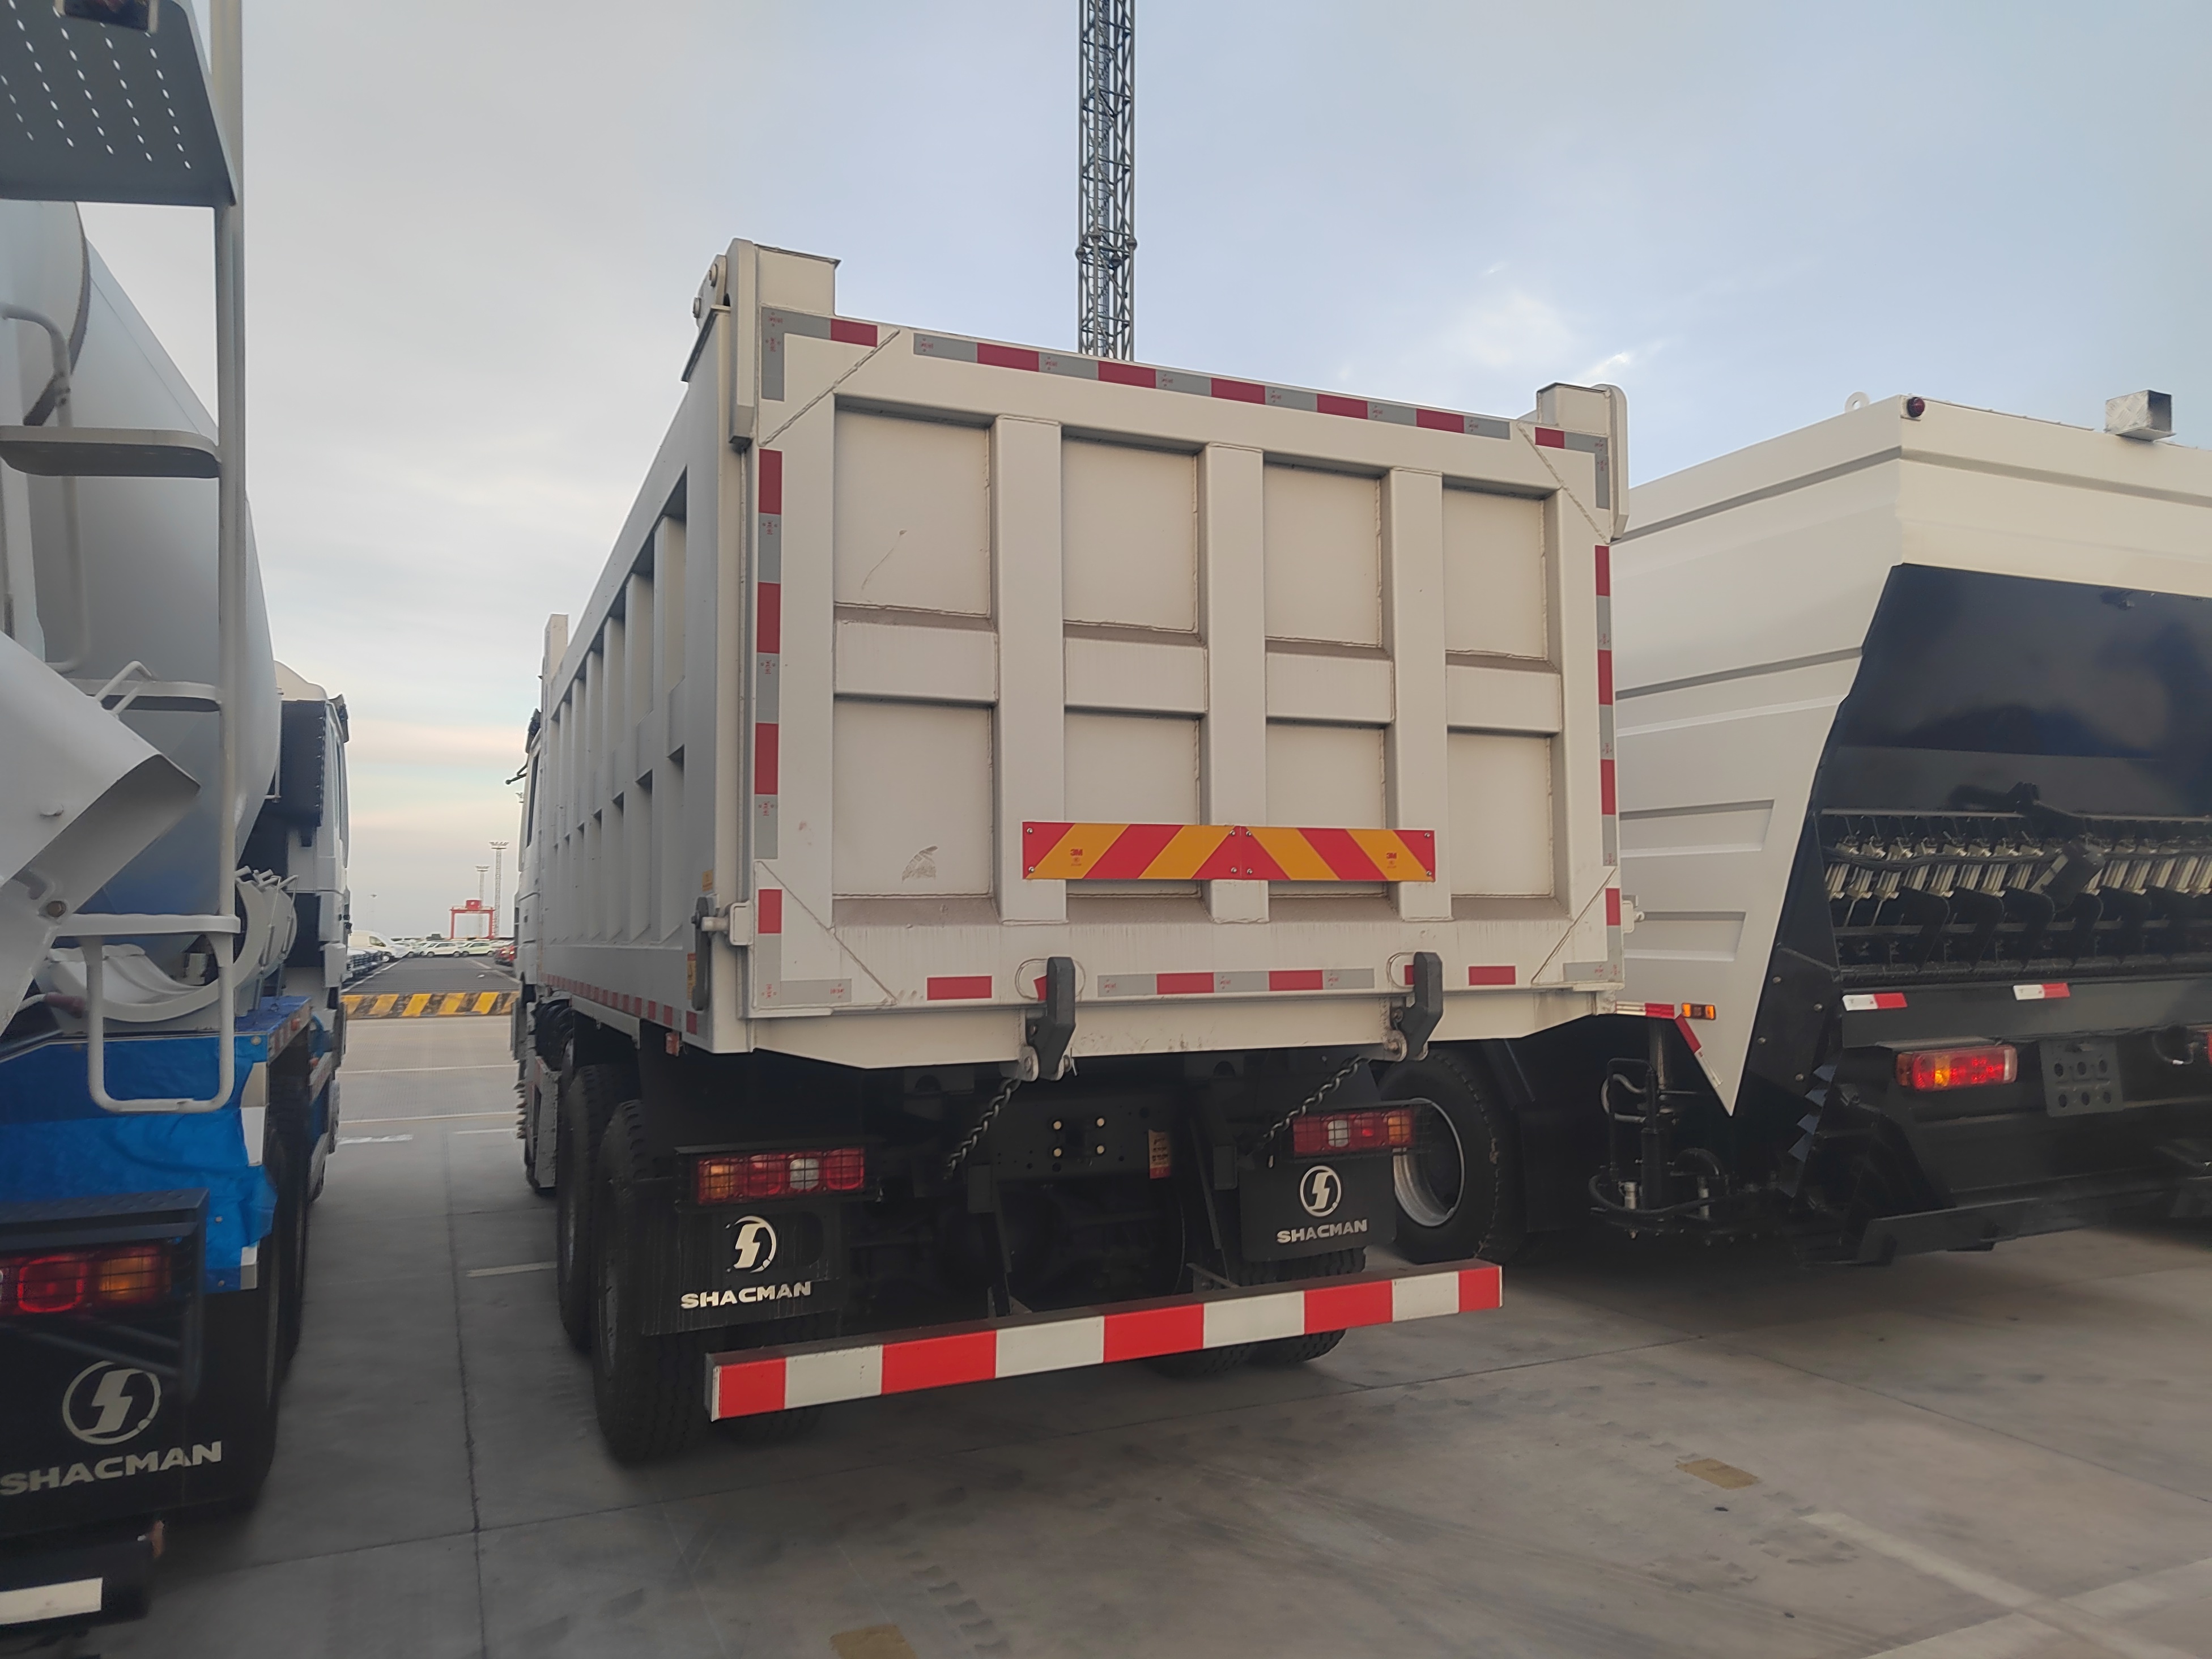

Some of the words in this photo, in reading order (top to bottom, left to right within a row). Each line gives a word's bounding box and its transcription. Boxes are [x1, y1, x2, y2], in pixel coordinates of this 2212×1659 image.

[1277, 1219, 1368, 1244] SHACMAN
[680, 1281, 811, 1309] SHACMAN
[0, 1441, 222, 1496] SHACMAN
